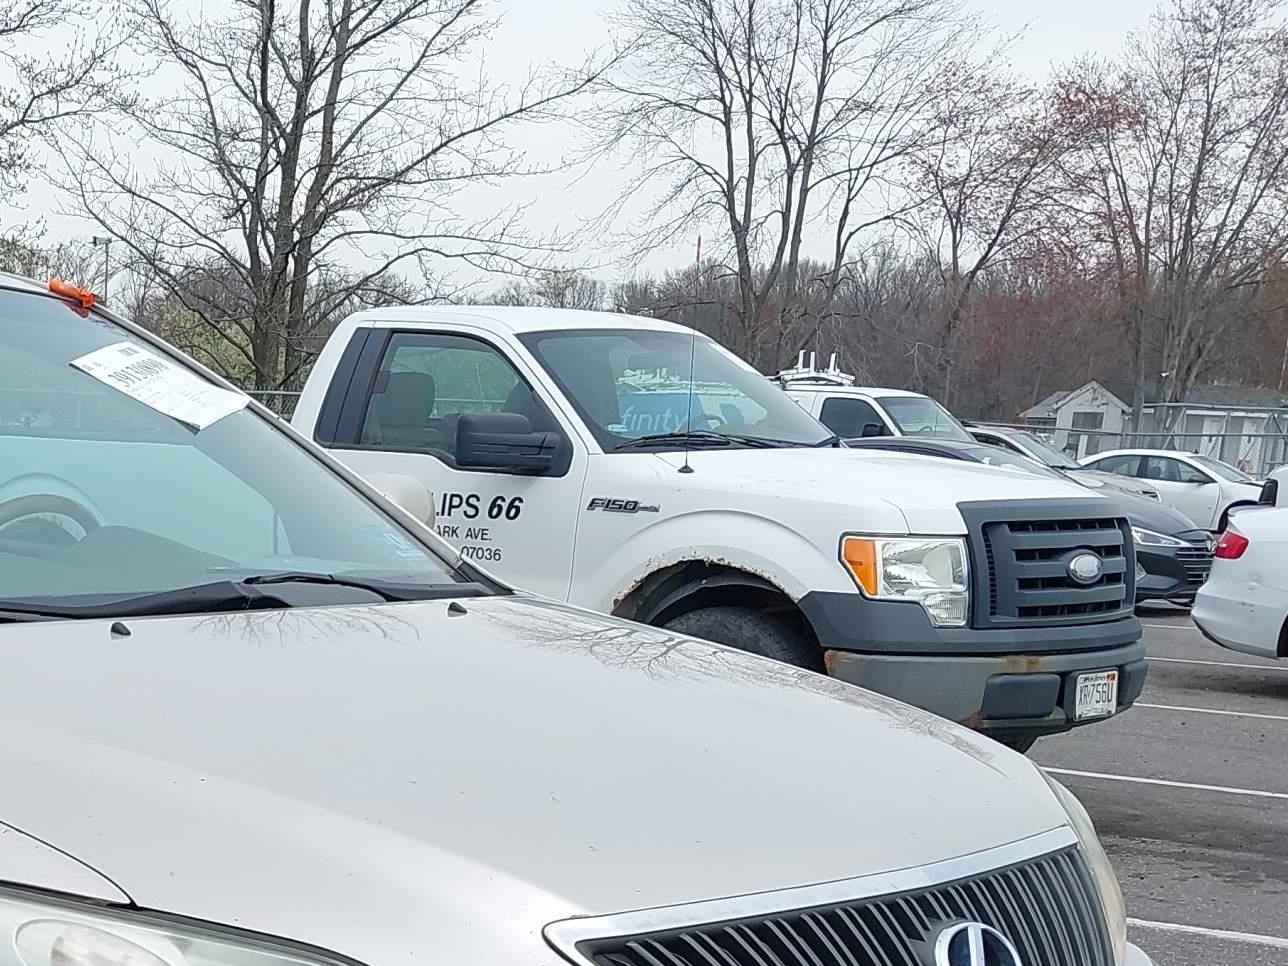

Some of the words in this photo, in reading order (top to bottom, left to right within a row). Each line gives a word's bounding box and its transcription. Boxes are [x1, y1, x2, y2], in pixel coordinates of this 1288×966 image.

[620, 405, 686, 433] finity
[435, 492, 480, 519] IPS
[487, 496, 524, 521] 66
[436, 525, 460, 539] ARK
[464, 527, 492, 541] AVE.
[460, 545, 502, 562] 07036
